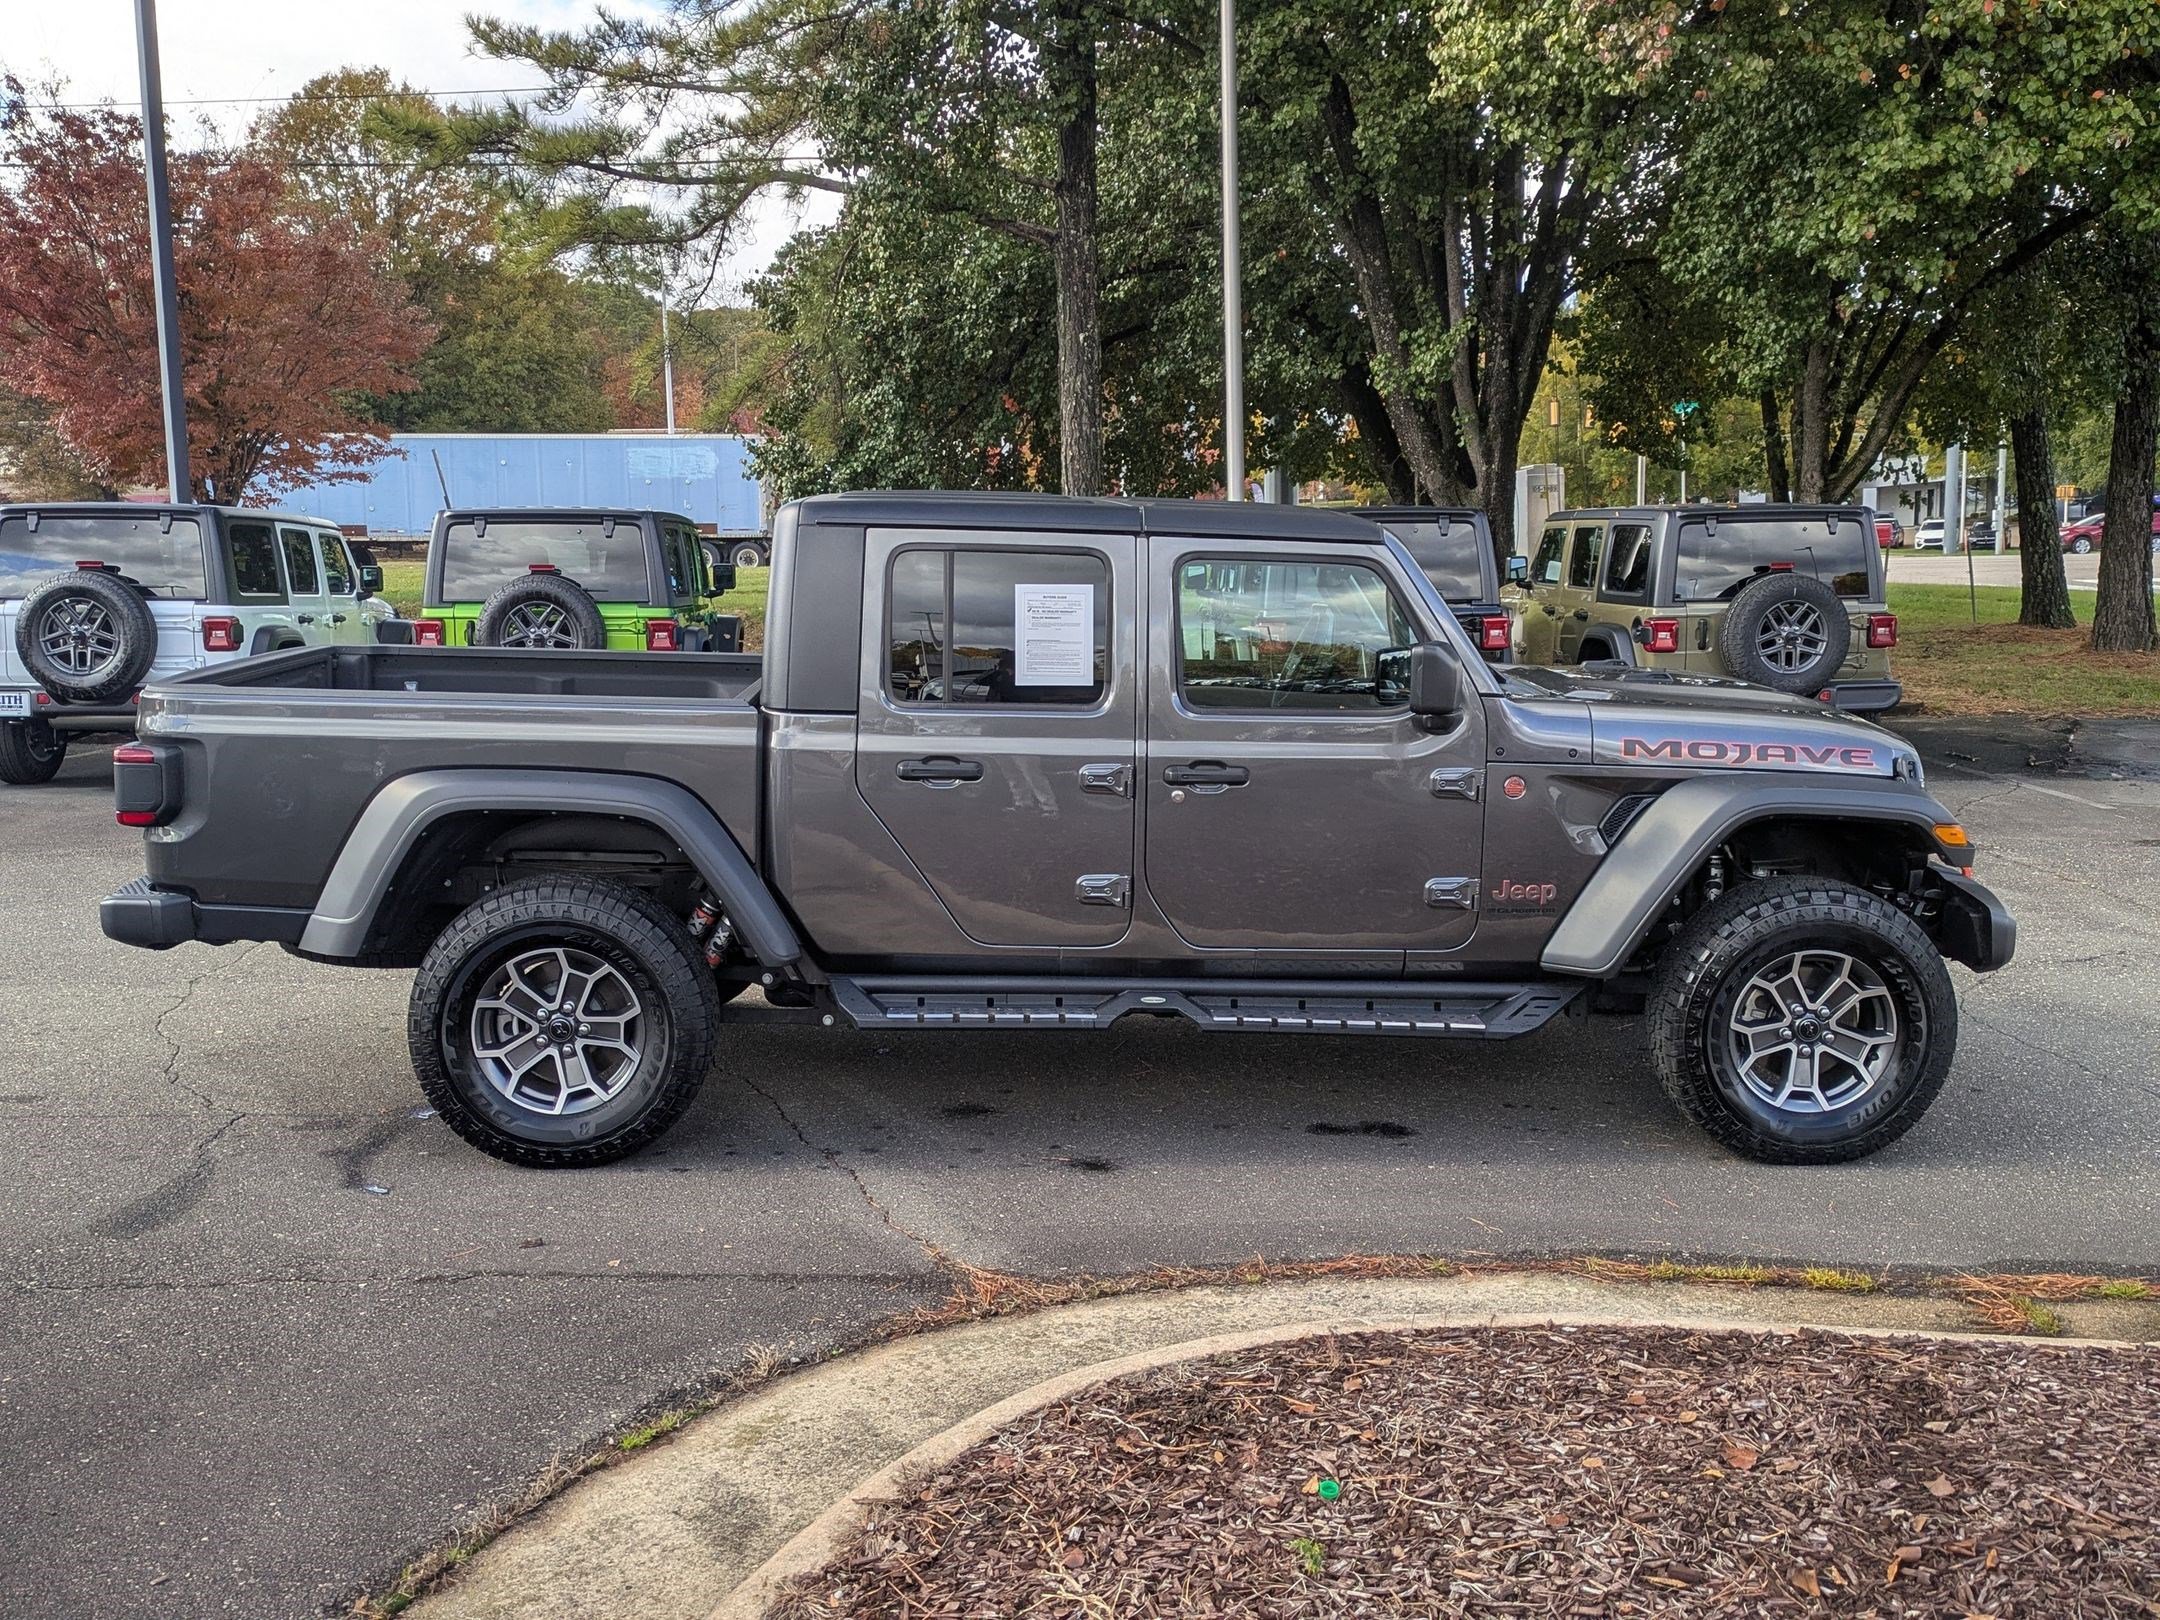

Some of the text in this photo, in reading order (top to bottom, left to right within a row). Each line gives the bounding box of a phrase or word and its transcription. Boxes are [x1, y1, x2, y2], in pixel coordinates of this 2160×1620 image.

[0, 695, 23, 705] ITH
[1621, 737, 1877, 768] MOJAVE
[1491, 879, 1557, 905] Jeep
[1847, 959, 1924, 1130] BRIDGESTONE
